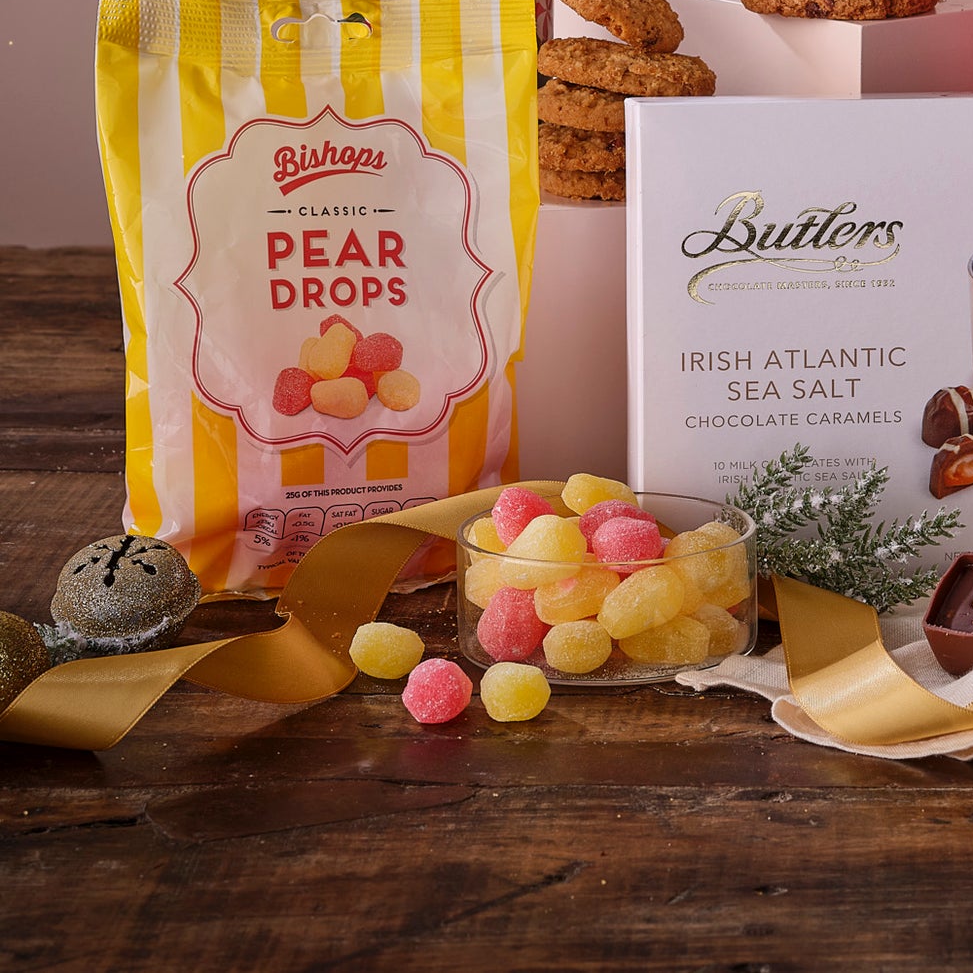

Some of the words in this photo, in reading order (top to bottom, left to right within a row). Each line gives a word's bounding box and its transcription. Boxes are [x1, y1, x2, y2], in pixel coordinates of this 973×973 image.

[273, 140, 387, 185] Bishops
[298, 206, 368, 216] CLASSIC
[681, 189, 904, 273] Butlers
[267, 228, 408, 270] PEAR
[708, 282, 772, 291] CHOCOLATE
[776, 281, 832, 291] MASTERS,
[834, 280, 866, 289] SINCE
[870, 279, 896, 288] 1932
[270, 277, 408, 311] DROPS
[681, 351, 752, 372] IRISH
[764, 346, 907, 370] ATLANTIC
[727, 381, 781, 401] SEA
[792, 379, 861, 399] SALT
[685, 413, 799, 429] CHOCOLATE
[806, 411, 902, 426] CARAMELS
[714, 461, 726, 471] 10
[730, 460, 757, 470] MILK
[718, 475, 748, 484] IRISH
[814, 472, 838, 481] SEA
[842, 471, 864, 481] SAL
[286, 491, 300, 499] 25G
[314, 489, 330, 497] THIS
[331, 487, 366, 496] PRODUCT
[368, 484, 403, 493] PROVIDES
[252, 512, 279, 521] ENERGY
[345, 509, 358, 517] FAT
[372, 507, 394, 515] SUGAR
[254, 535, 271, 547] 5%
